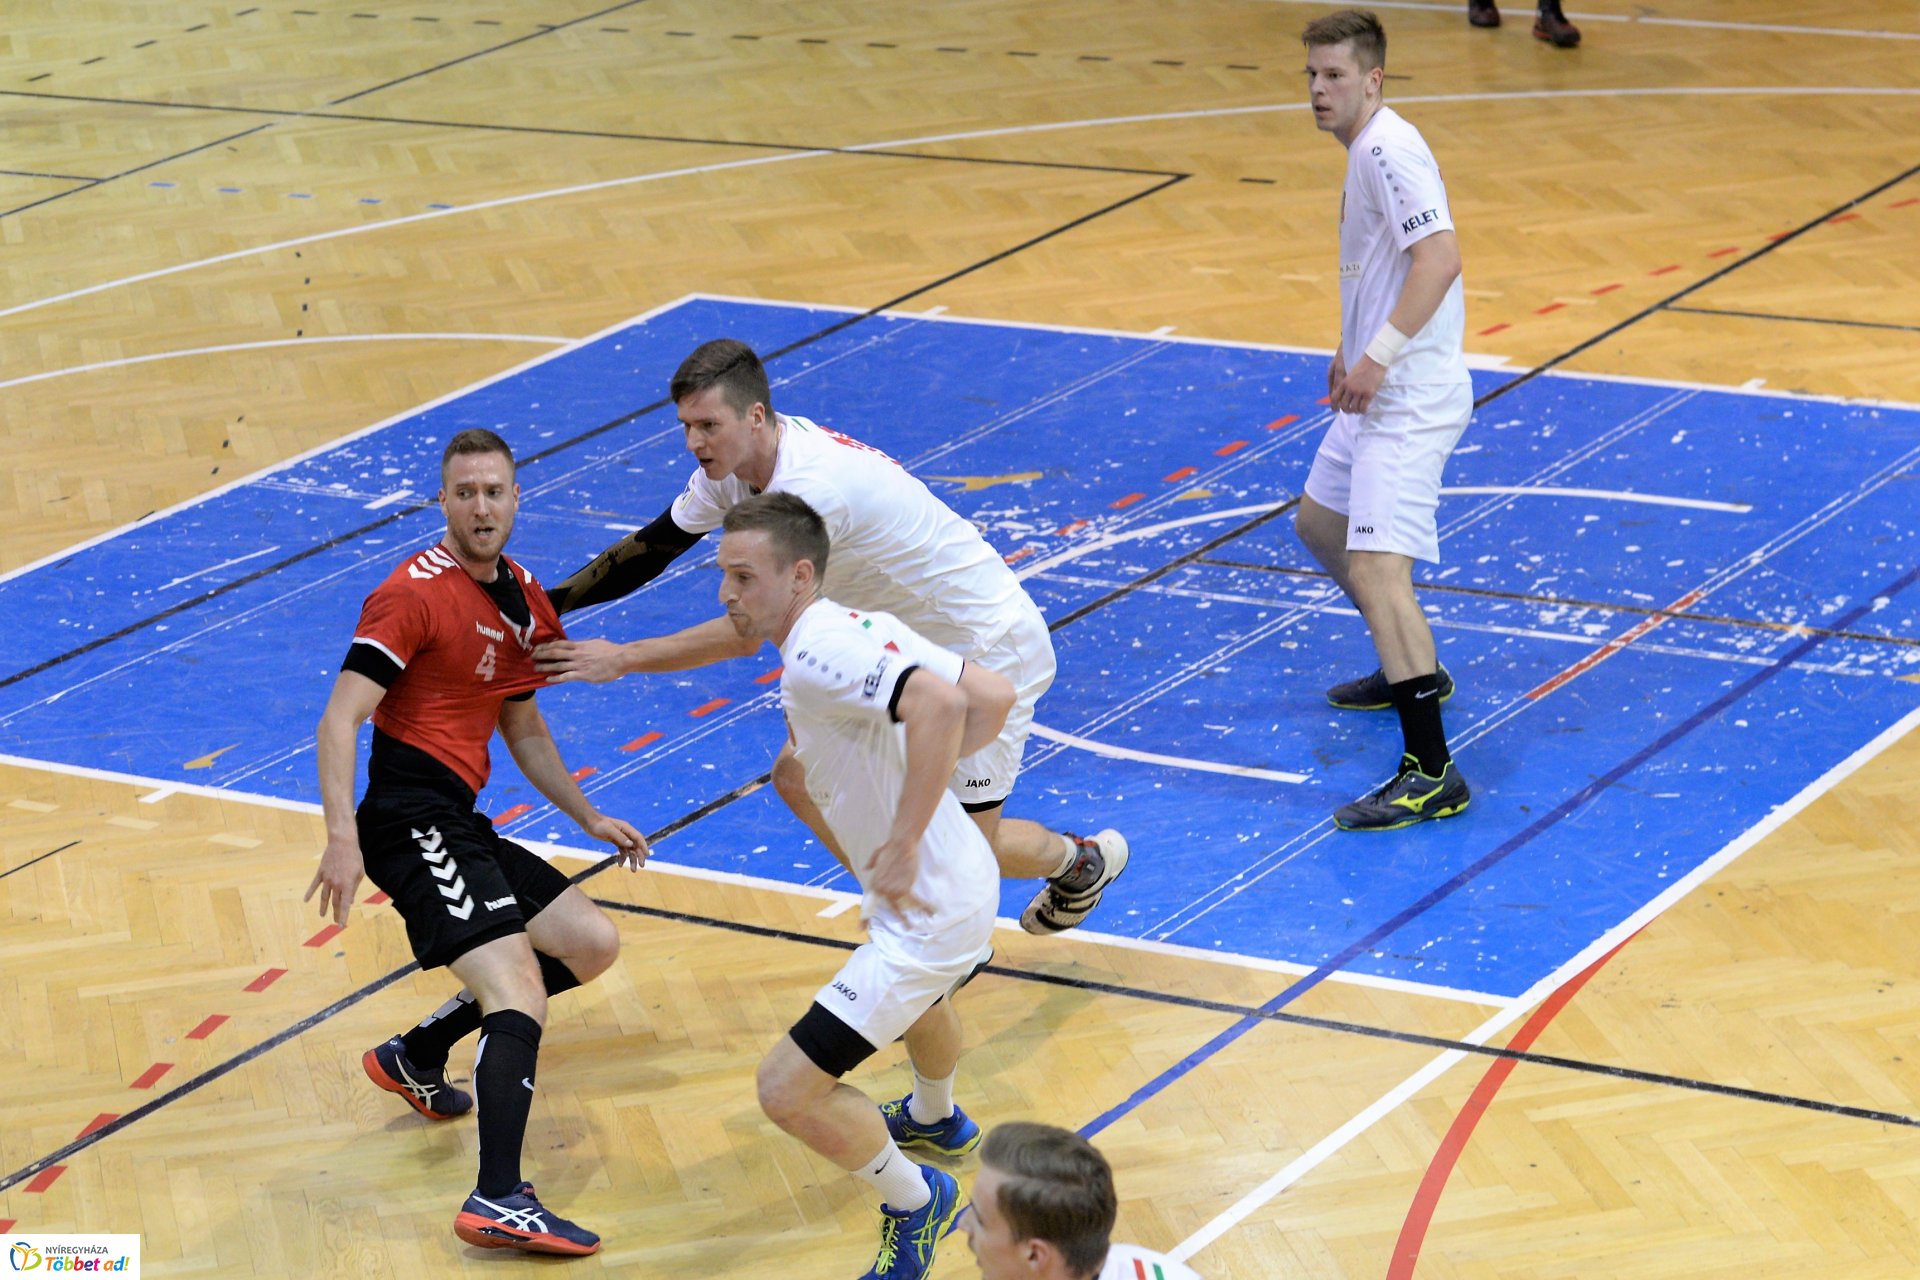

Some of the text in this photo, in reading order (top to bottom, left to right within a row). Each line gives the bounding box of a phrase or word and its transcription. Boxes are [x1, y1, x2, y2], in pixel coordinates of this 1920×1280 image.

[1402, 209, 1439, 234] KELET
[1354, 526, 1374, 534] AKO
[476, 621, 504, 642] hummel
[475, 643, 496, 681] 4
[965, 778, 991, 788] JAKO
[832, 981, 857, 1001] JAKO
